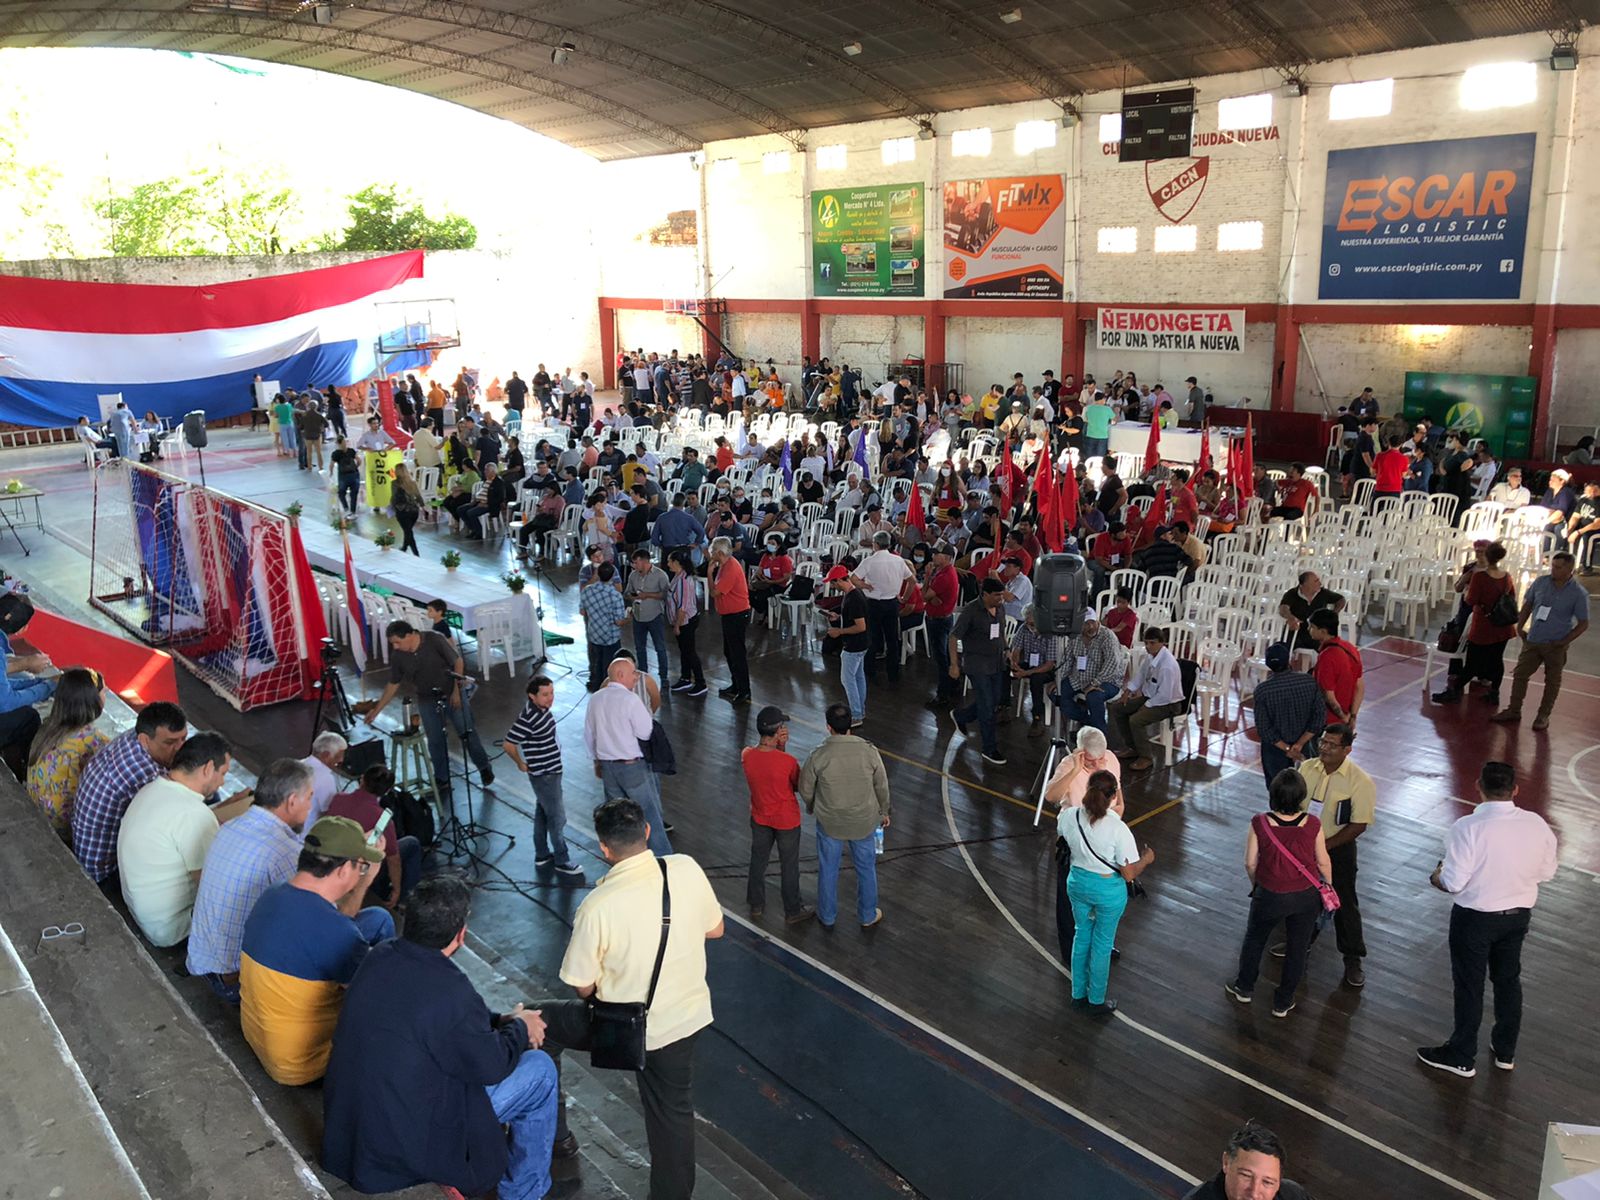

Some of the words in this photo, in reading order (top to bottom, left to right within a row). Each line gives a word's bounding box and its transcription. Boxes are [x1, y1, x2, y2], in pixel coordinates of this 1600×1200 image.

[1125, 110, 1140, 118] LOCAL
[1168, 133, 1187, 142] FALTAS
[1192, 131, 1234, 147] CIUDAD
[1237, 126, 1280, 143] NUEVA
[1160, 166, 1199, 201] CACN
[851, 191, 878, 200] Cooperativa
[1337, 169, 1518, 234] ESCAR
[1384, 218, 1507, 235] LOGISTIC
[1340, 238, 1372, 246] NUESTRA
[1422, 235, 1433, 243] TU
[1434, 234, 1461, 243] MEJOR
[1462, 231, 1504, 242] GARANTÍA
[991, 245, 1030, 253] MUSCULACIÓN
[1354, 262, 1483, 273] www.escarlogistic.com.py
[1102, 309, 1233, 332] ÑEMONGETA
[1101, 331, 1121, 347] POR
[1125, 332, 1148, 348] UNA
[1152, 334, 1196, 350] PATRIA
[1200, 335, 1240, 351] NUEVA
